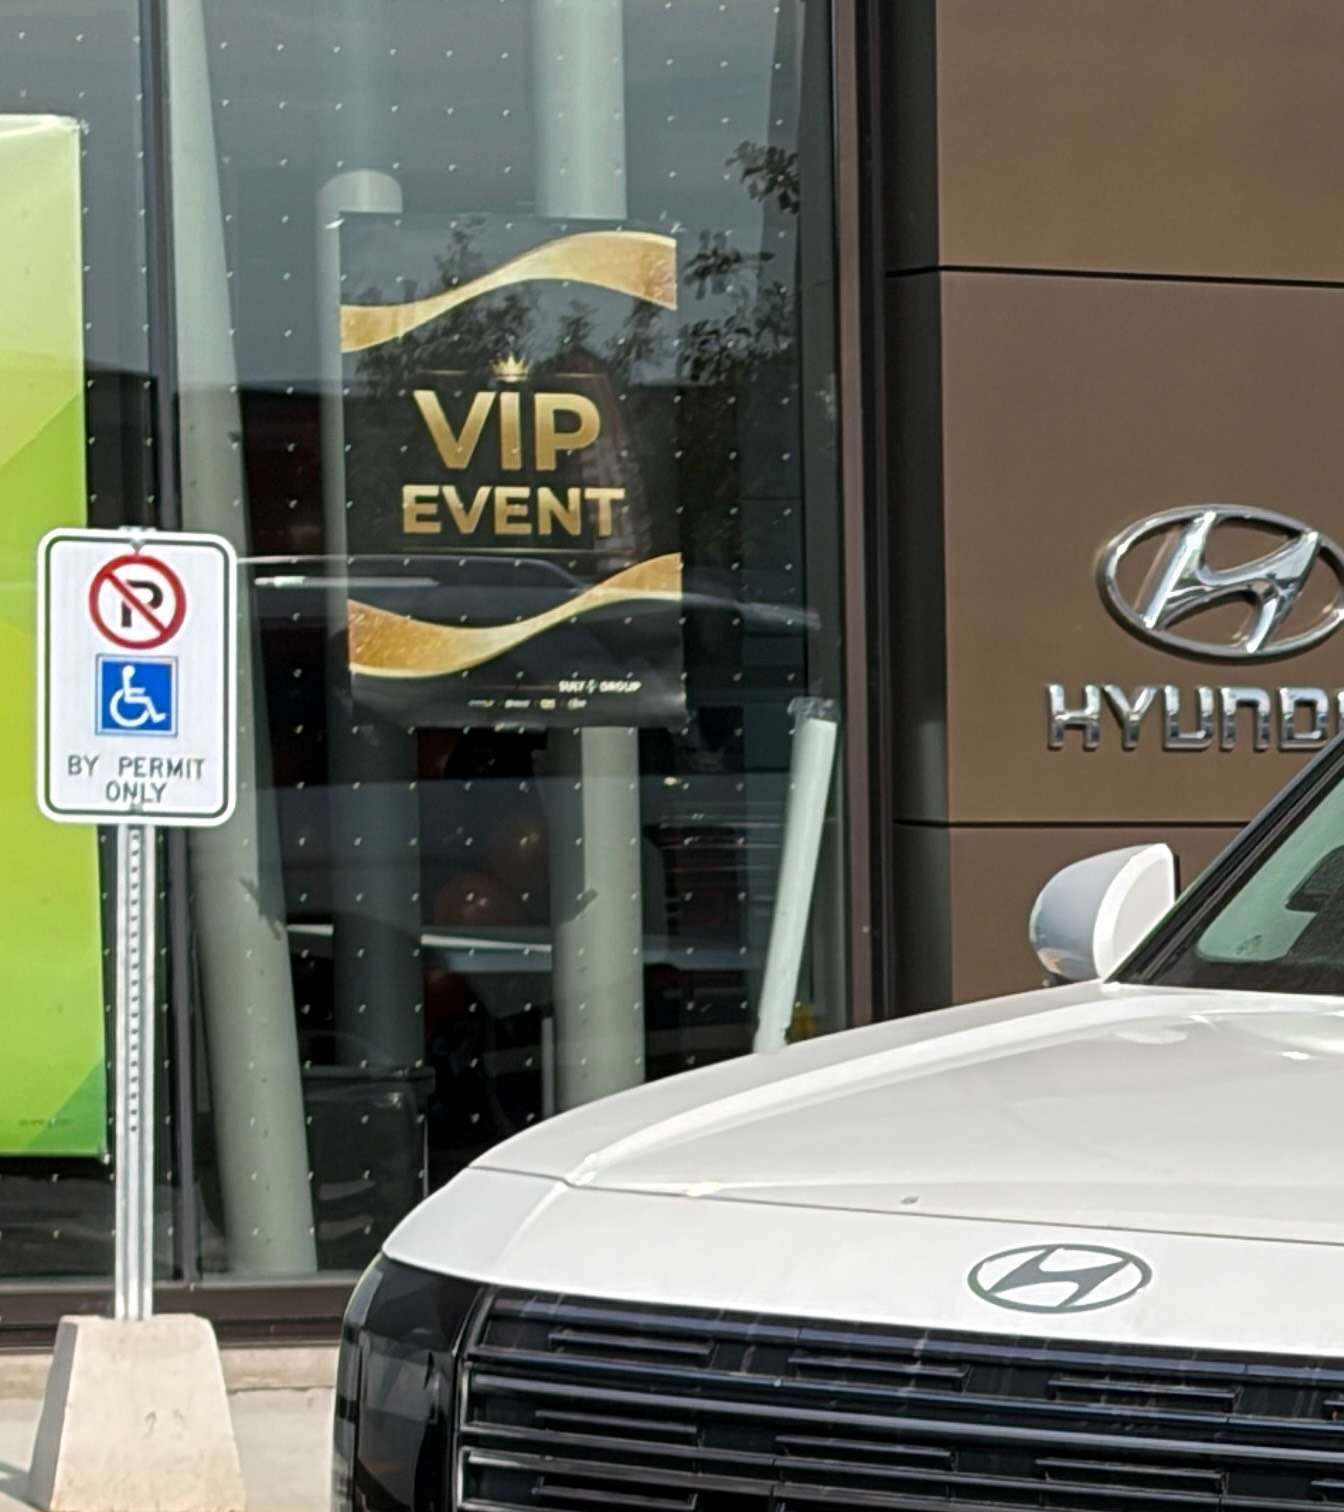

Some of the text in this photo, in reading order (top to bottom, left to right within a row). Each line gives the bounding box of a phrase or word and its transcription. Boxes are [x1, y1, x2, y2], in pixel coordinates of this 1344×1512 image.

[413, 390, 600, 470] VIP
[402, 484, 626, 536] EVENT
[67, 755, 205, 779] BY PERMIT
[106, 781, 167, 803] ONLY
